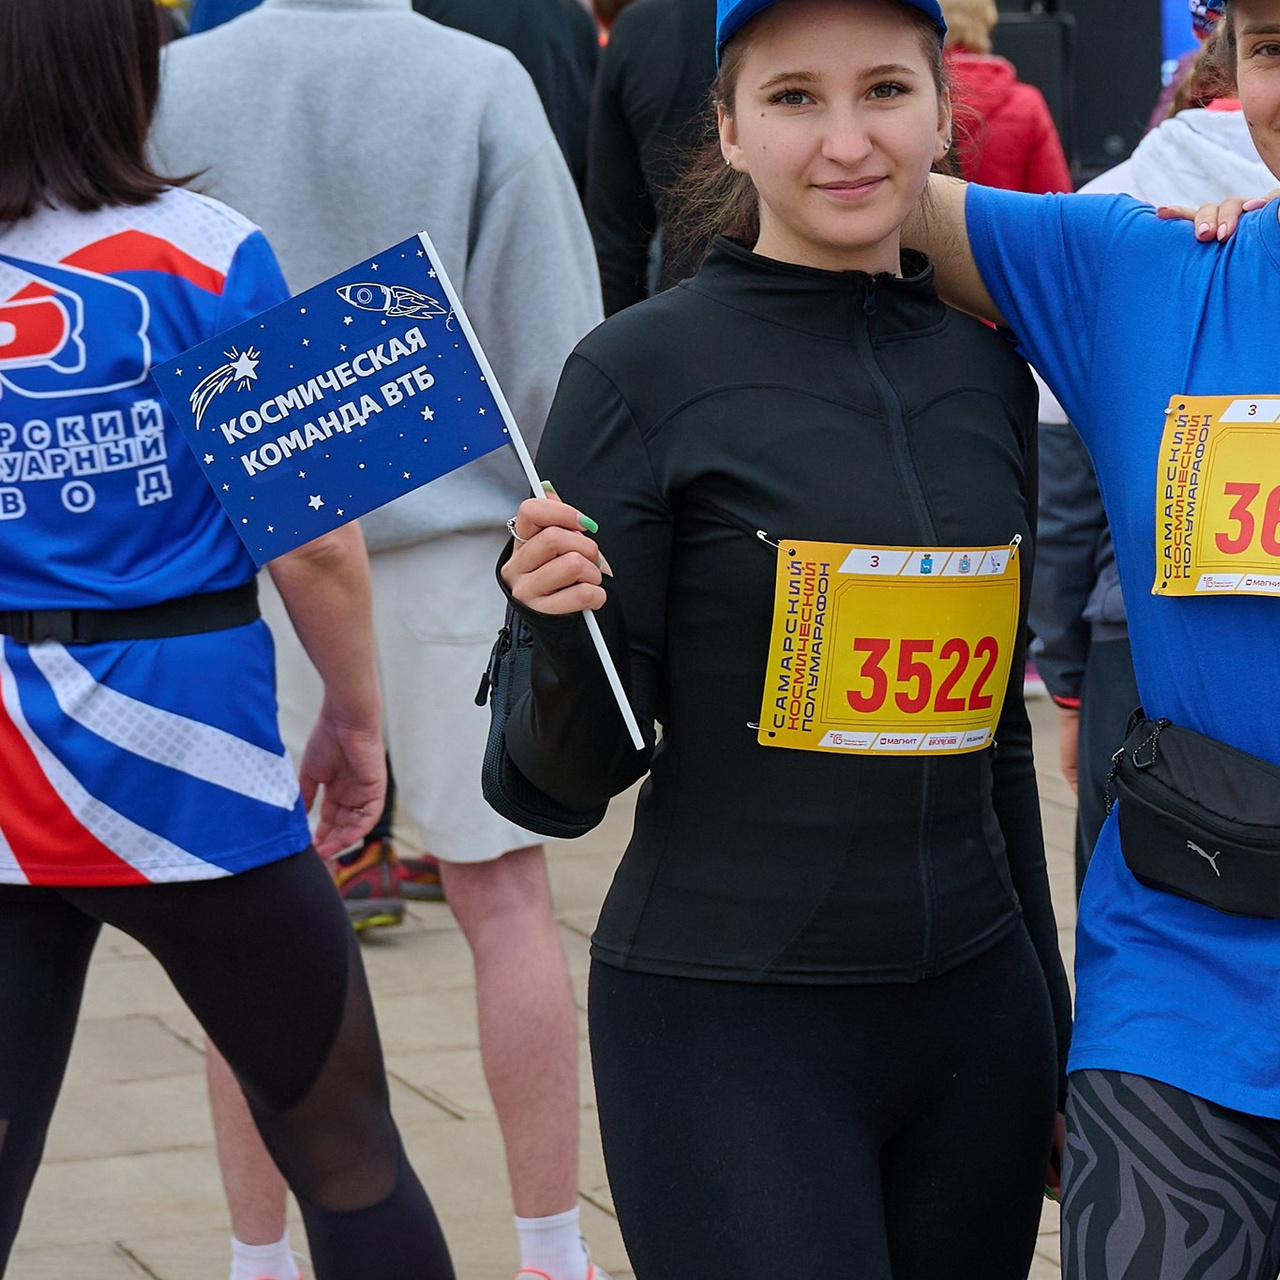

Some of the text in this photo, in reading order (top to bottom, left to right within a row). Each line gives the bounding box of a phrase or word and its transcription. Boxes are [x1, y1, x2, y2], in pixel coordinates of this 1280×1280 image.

[220, 327, 427, 445] КОСМИЧЕСКАЯ
[240, 365, 435, 476] КОМАНДА ВТБ
[1247, 404, 1257, 416] 3
[870, 555, 880, 568] 3
[1163, 414, 1189, 579] САМАРСКИЙ
[1174, 415, 1200, 579] КОСМИЧЕСКИЙ
[1183, 415, 1213, 578] ПОЛУМАРАФОН
[773, 561, 802, 729] САМАРСКИЙ
[787, 562, 817, 730] КОСМИЧЕСКИЙ
[802, 563, 830, 732] ПОЛУМАРАФОН
[846, 636, 999, 714] 3522
